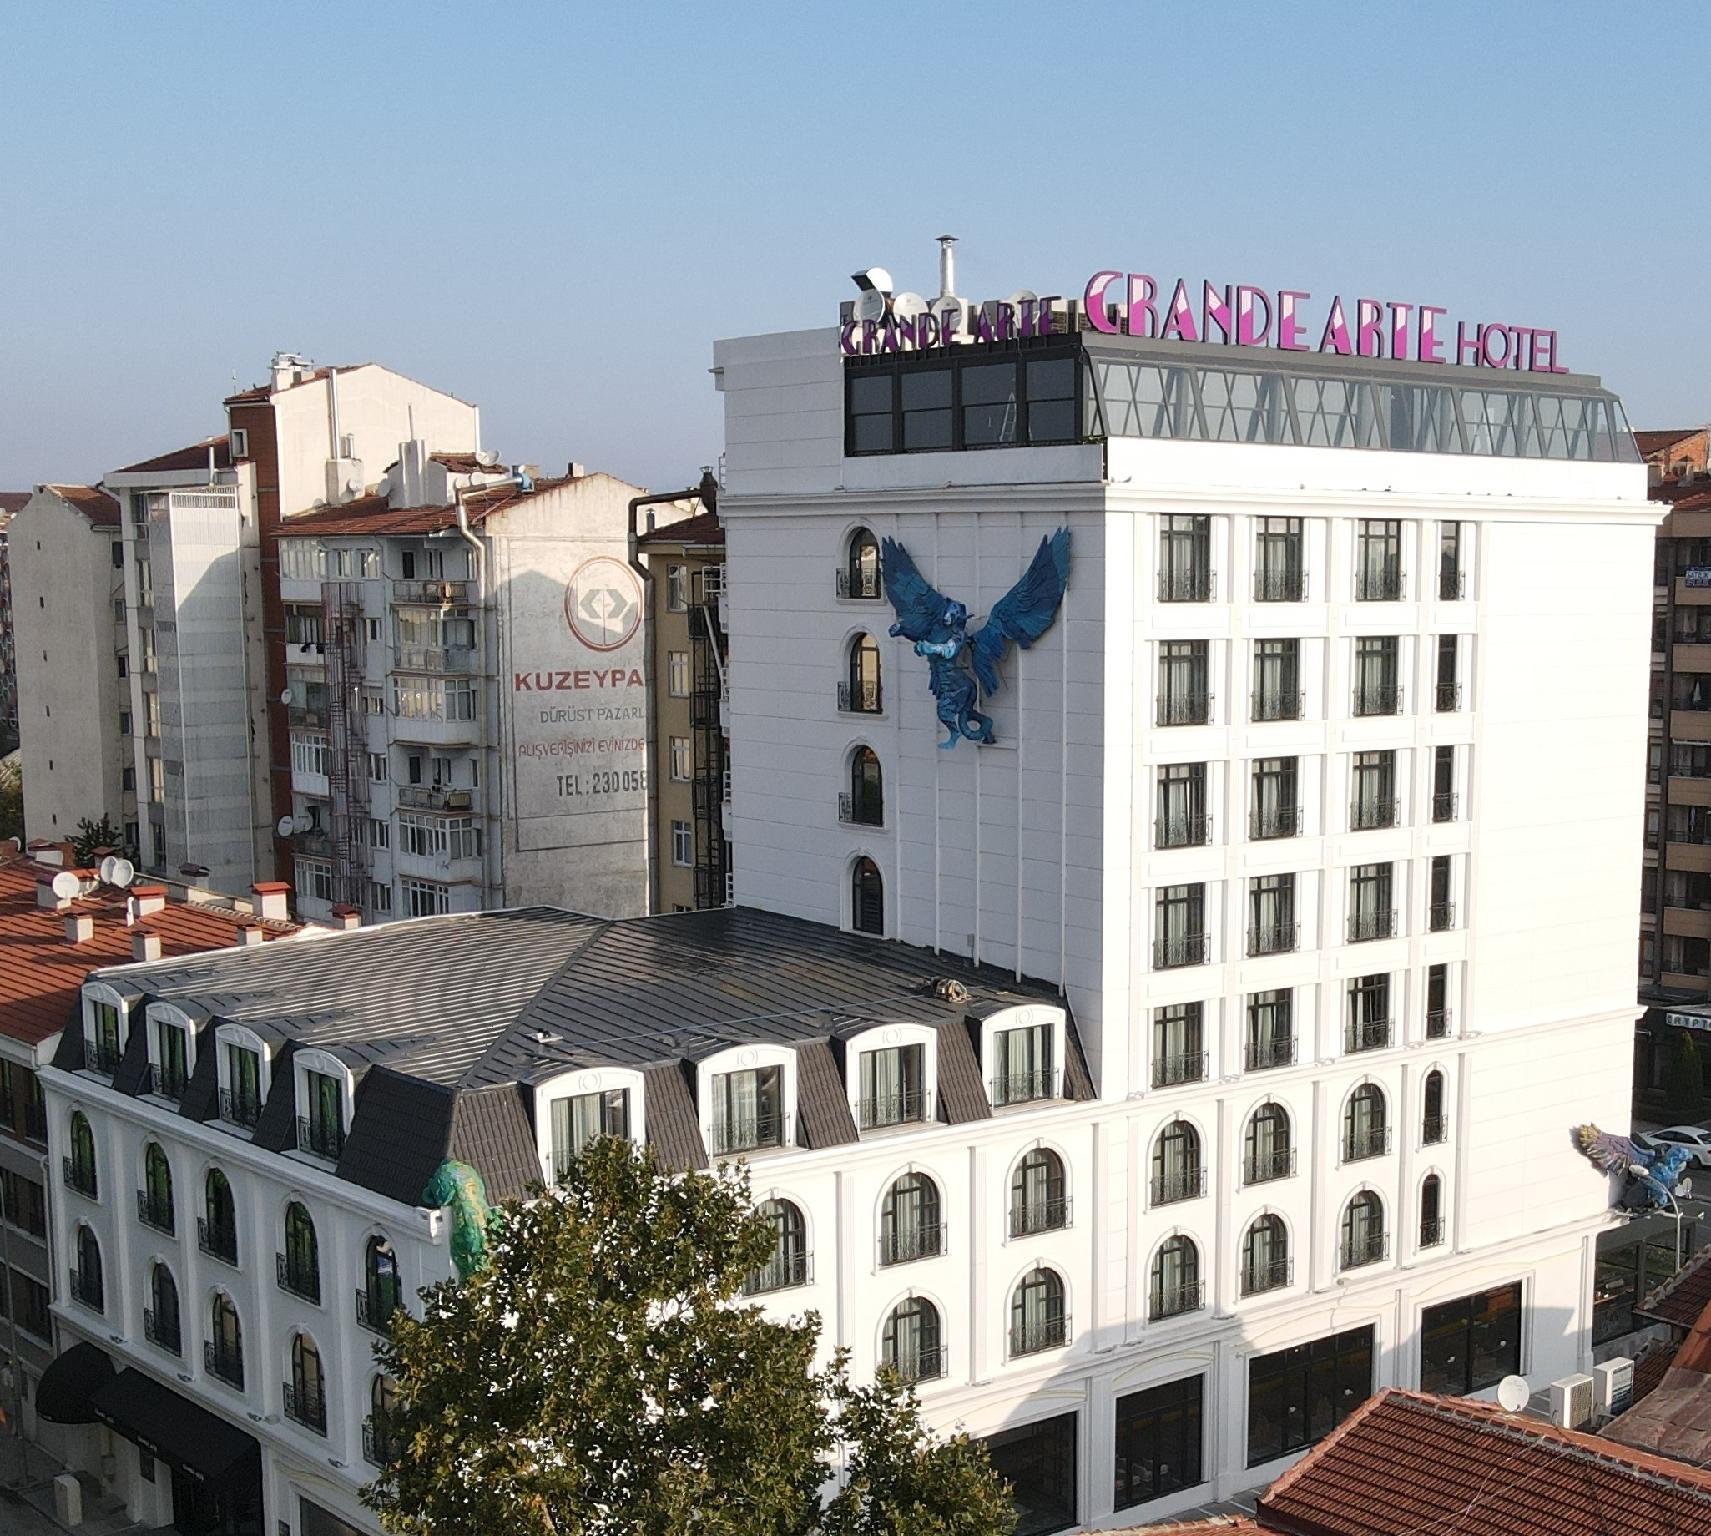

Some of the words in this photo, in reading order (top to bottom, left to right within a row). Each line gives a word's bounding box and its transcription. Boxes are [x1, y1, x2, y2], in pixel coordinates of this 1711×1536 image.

[841, 308, 958, 355] GRANDE
[977, 296, 1062, 343] ARTE
[1084, 270, 1310, 351] GRANDE
[1319, 295, 1447, 364] ARTE
[1456, 320, 1569, 373] HOTEL
[540, 706, 593, 724] DÜRÜST
